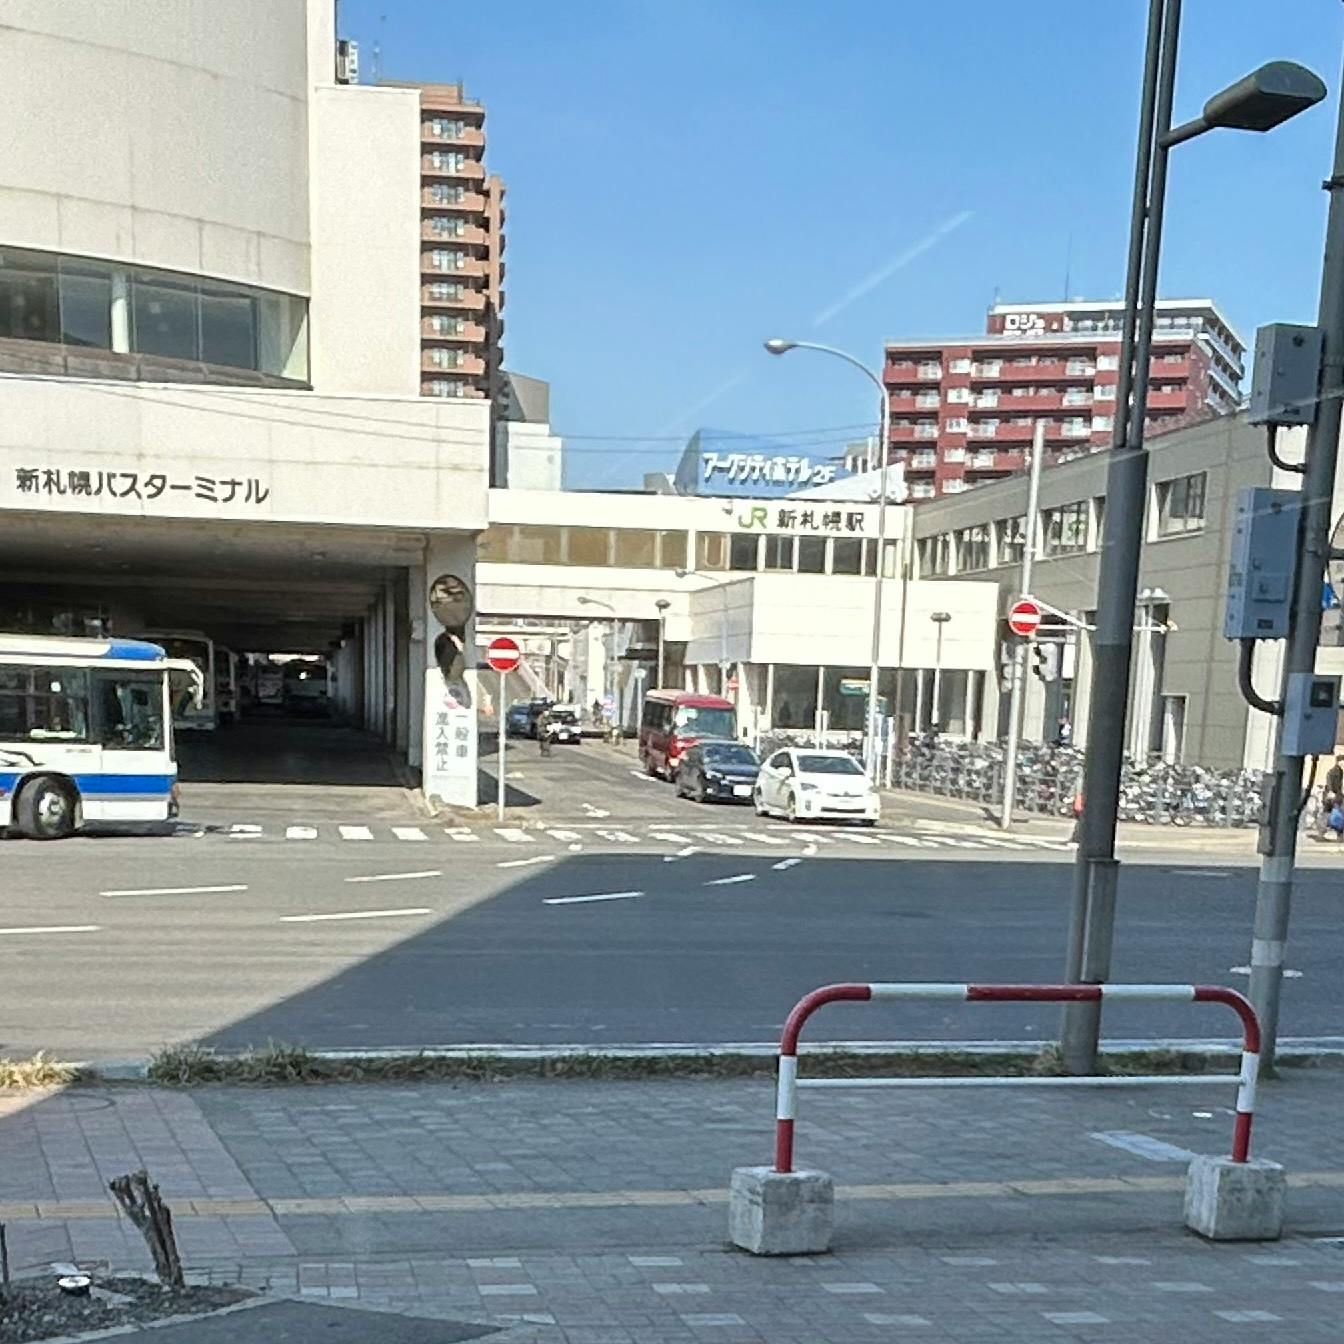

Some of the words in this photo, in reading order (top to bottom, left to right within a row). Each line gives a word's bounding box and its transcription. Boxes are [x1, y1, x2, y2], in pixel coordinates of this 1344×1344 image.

[15, 467, 270, 503] 新札幌バスターミナル
[738, 506, 768, 529] JR
[777, 508, 864, 532] 新札幌駅
